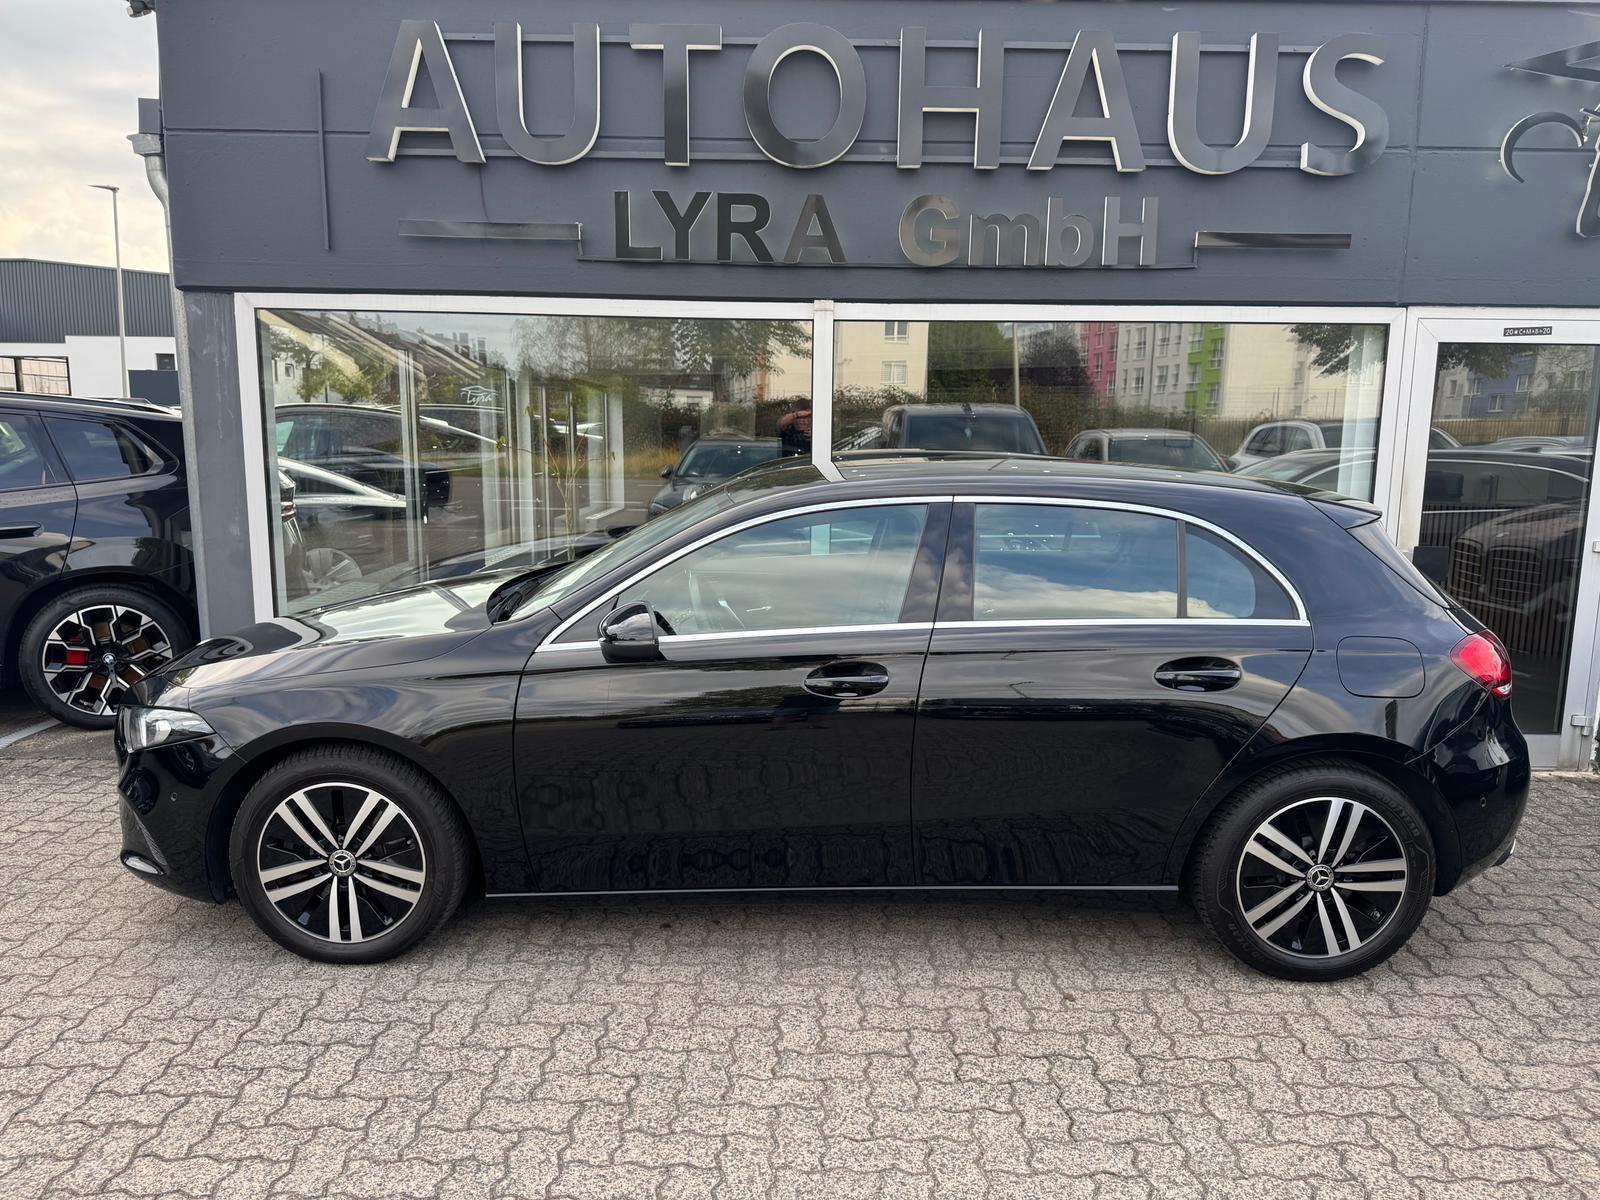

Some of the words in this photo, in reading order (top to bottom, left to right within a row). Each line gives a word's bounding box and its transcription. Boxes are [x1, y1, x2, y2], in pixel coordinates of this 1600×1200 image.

[366, 21, 1390, 176] AUTOHAUS
[613, 189, 847, 265] LYRA
[899, 194, 1160, 268] GmbH
